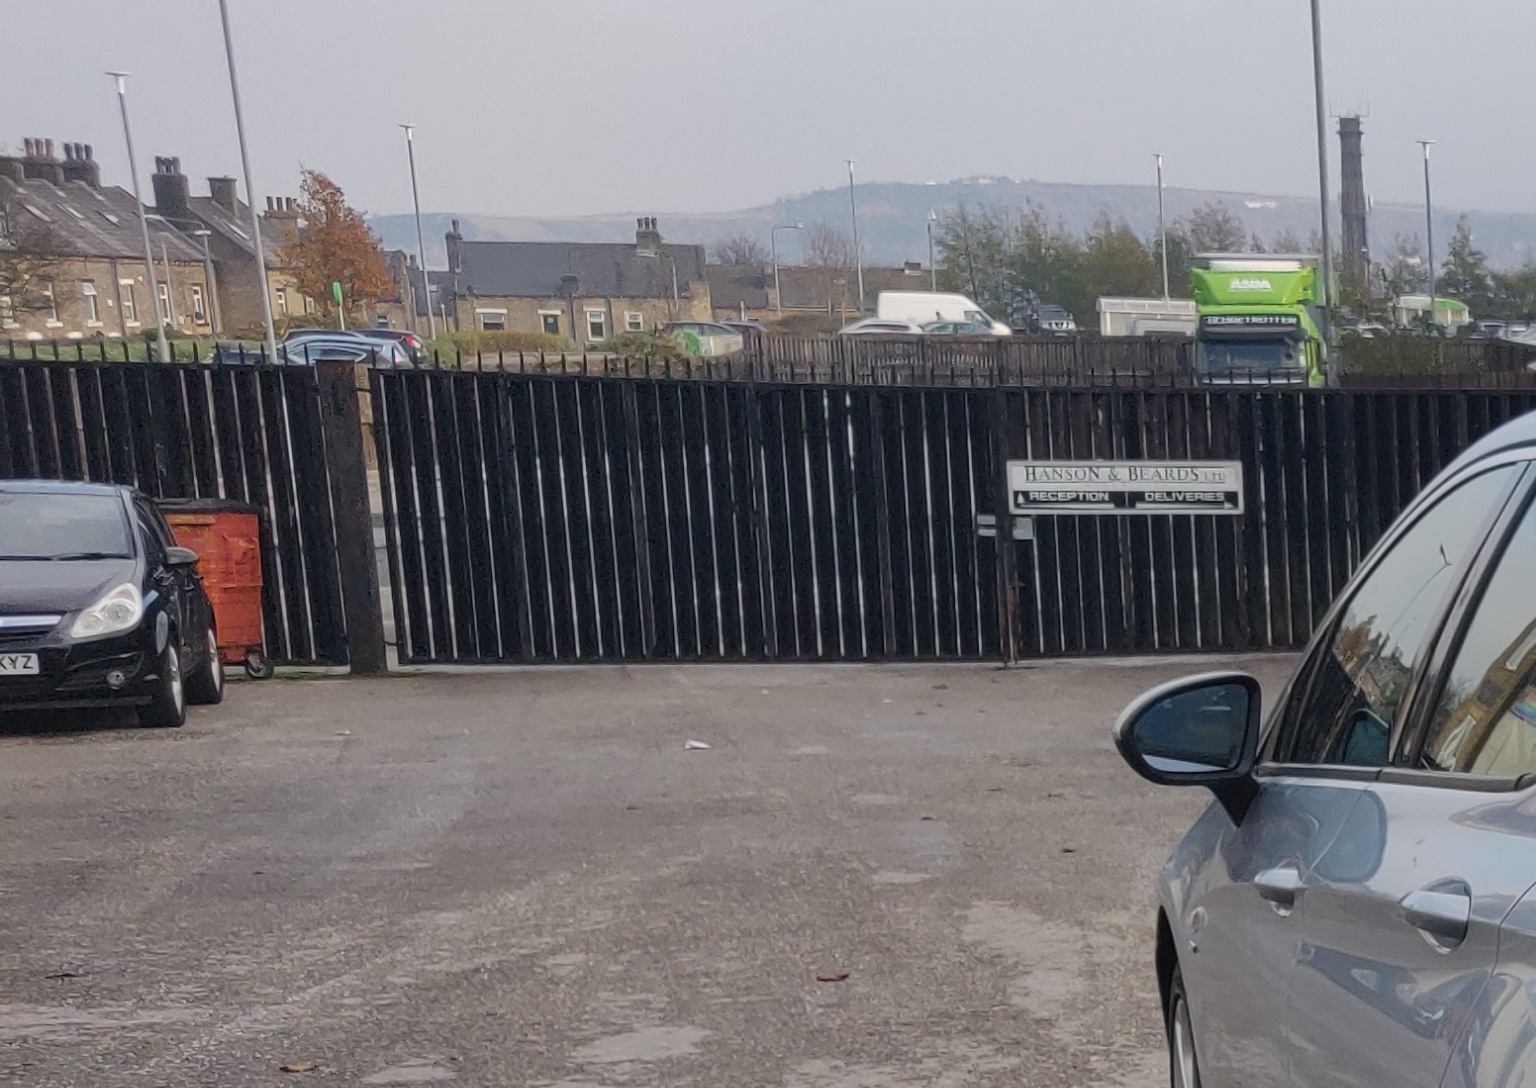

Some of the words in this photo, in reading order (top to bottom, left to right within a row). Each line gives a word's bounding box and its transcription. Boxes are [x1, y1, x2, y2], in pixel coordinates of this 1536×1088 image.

[1024, 465, 1101, 482] HANSON
[1108, 466, 1122, 482] &
[1128, 465, 1200, 482] BEARDS
[1029, 491, 1110, 502] RECEPTION
[1144, 491, 1226, 502] DELIVERIES
